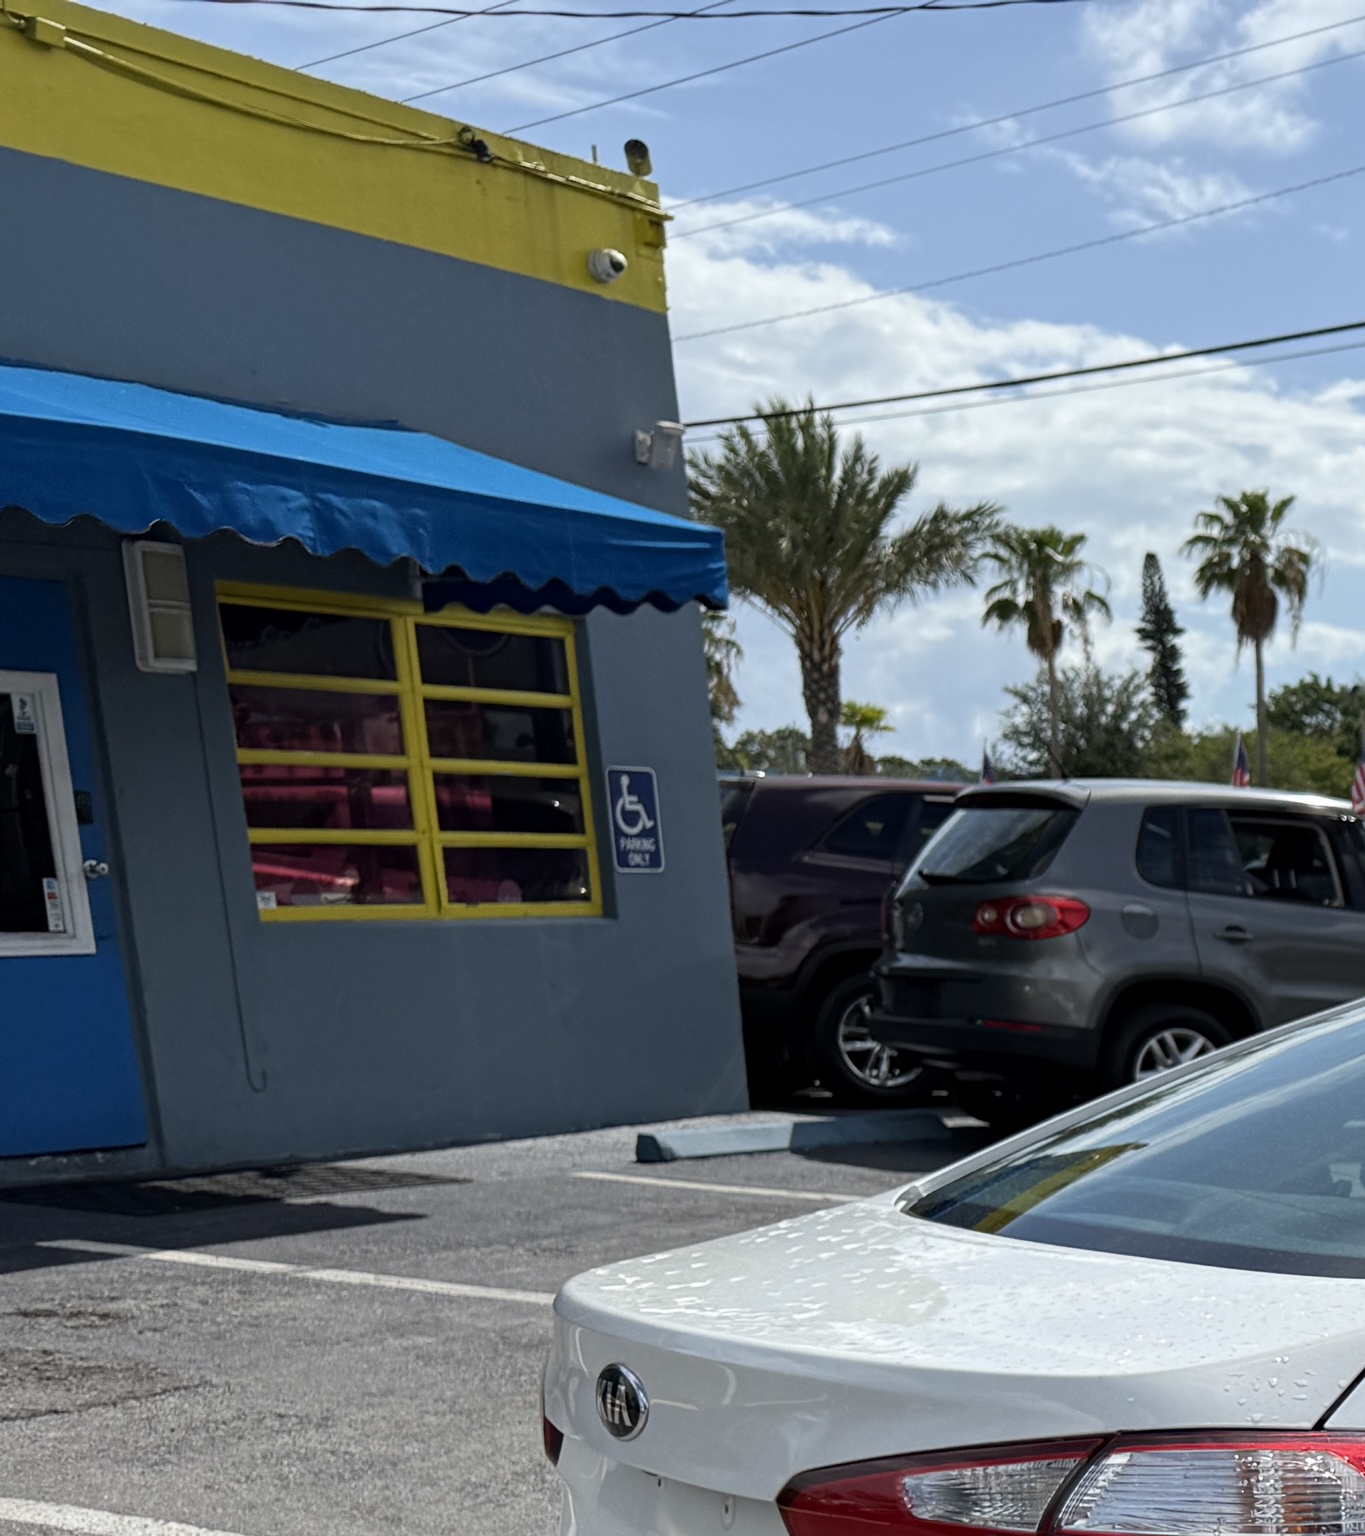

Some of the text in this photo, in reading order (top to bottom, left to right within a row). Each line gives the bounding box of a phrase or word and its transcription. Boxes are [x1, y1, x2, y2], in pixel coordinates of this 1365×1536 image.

[620, 836, 656, 852] PARKING
[628, 851, 650, 867] ONLY
[597, 1378, 633, 1427] KIA
